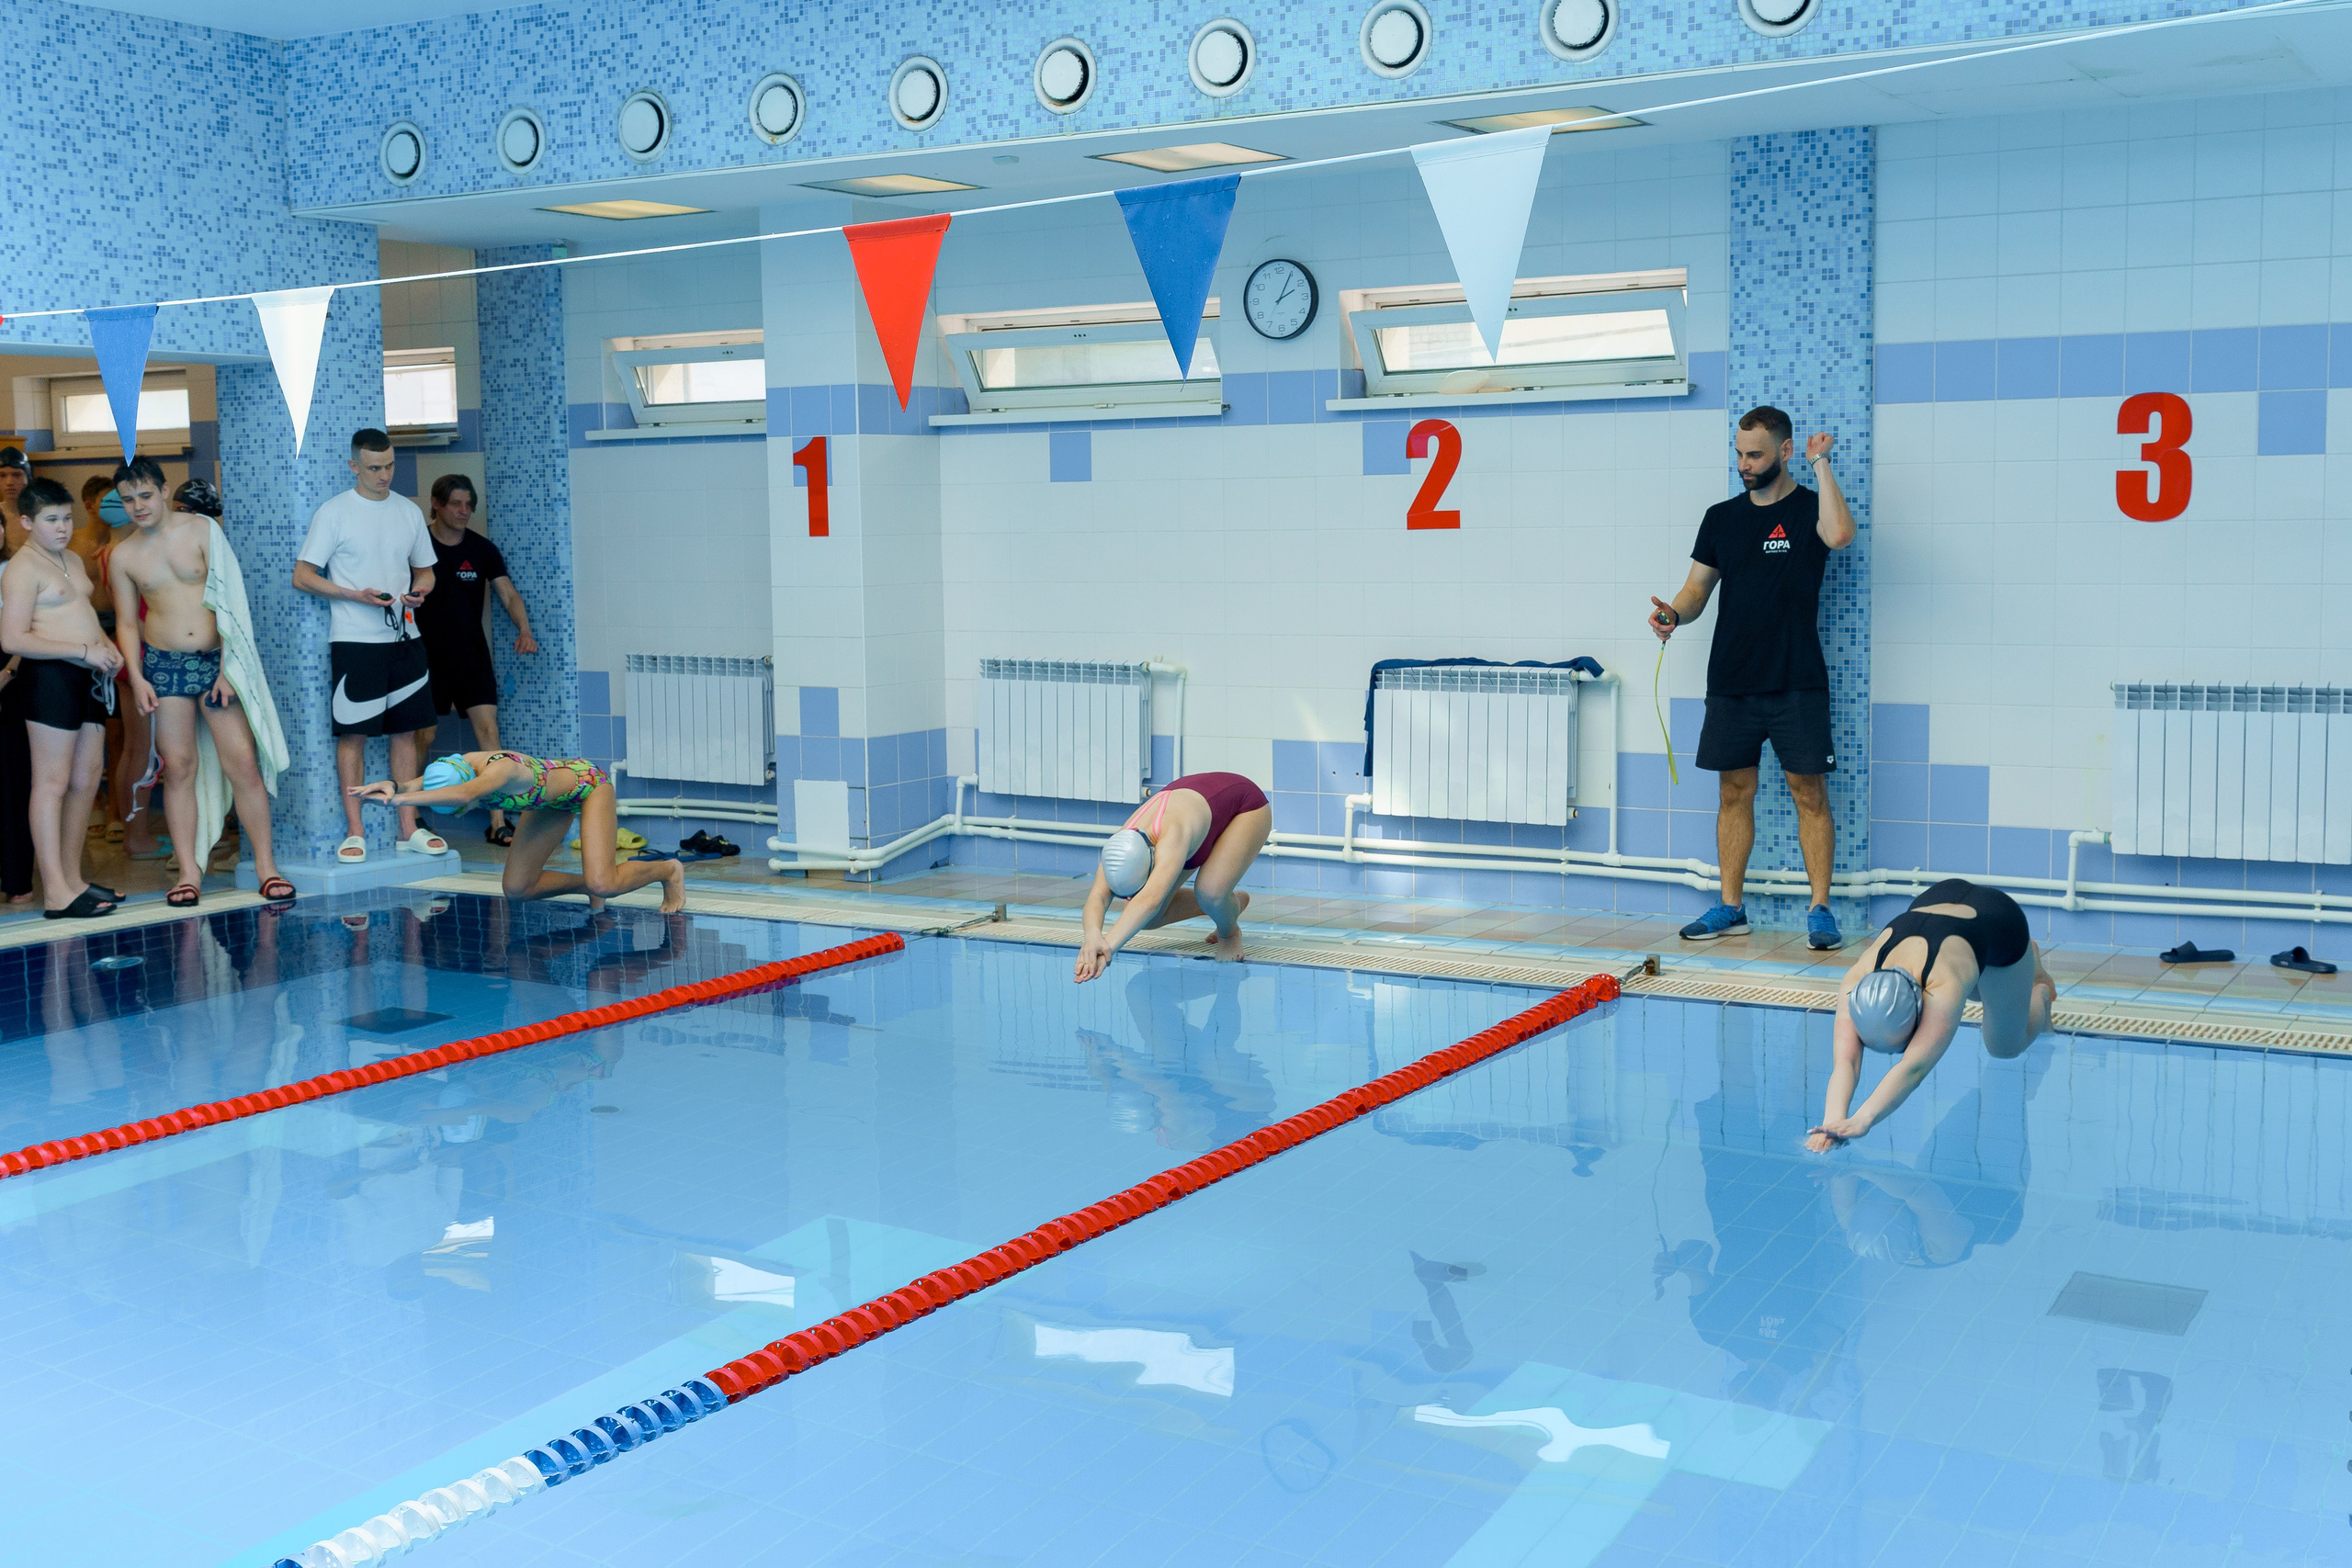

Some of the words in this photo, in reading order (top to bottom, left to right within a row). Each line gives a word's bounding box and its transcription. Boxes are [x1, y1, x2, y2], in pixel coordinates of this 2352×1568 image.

[1274, 266, 1284, 275] 12
[1255, 283, 1265, 291] 10
[1252, 298, 1260, 306] 9
[1266, 321, 1273, 329] 7
[1290, 318, 1298, 326] 5
[2117, 393, 2192, 522] 3
[1407, 420, 1462, 530] 2
[794, 437, 829, 536] 1
[1763, 540, 1791, 550] ГОРА
